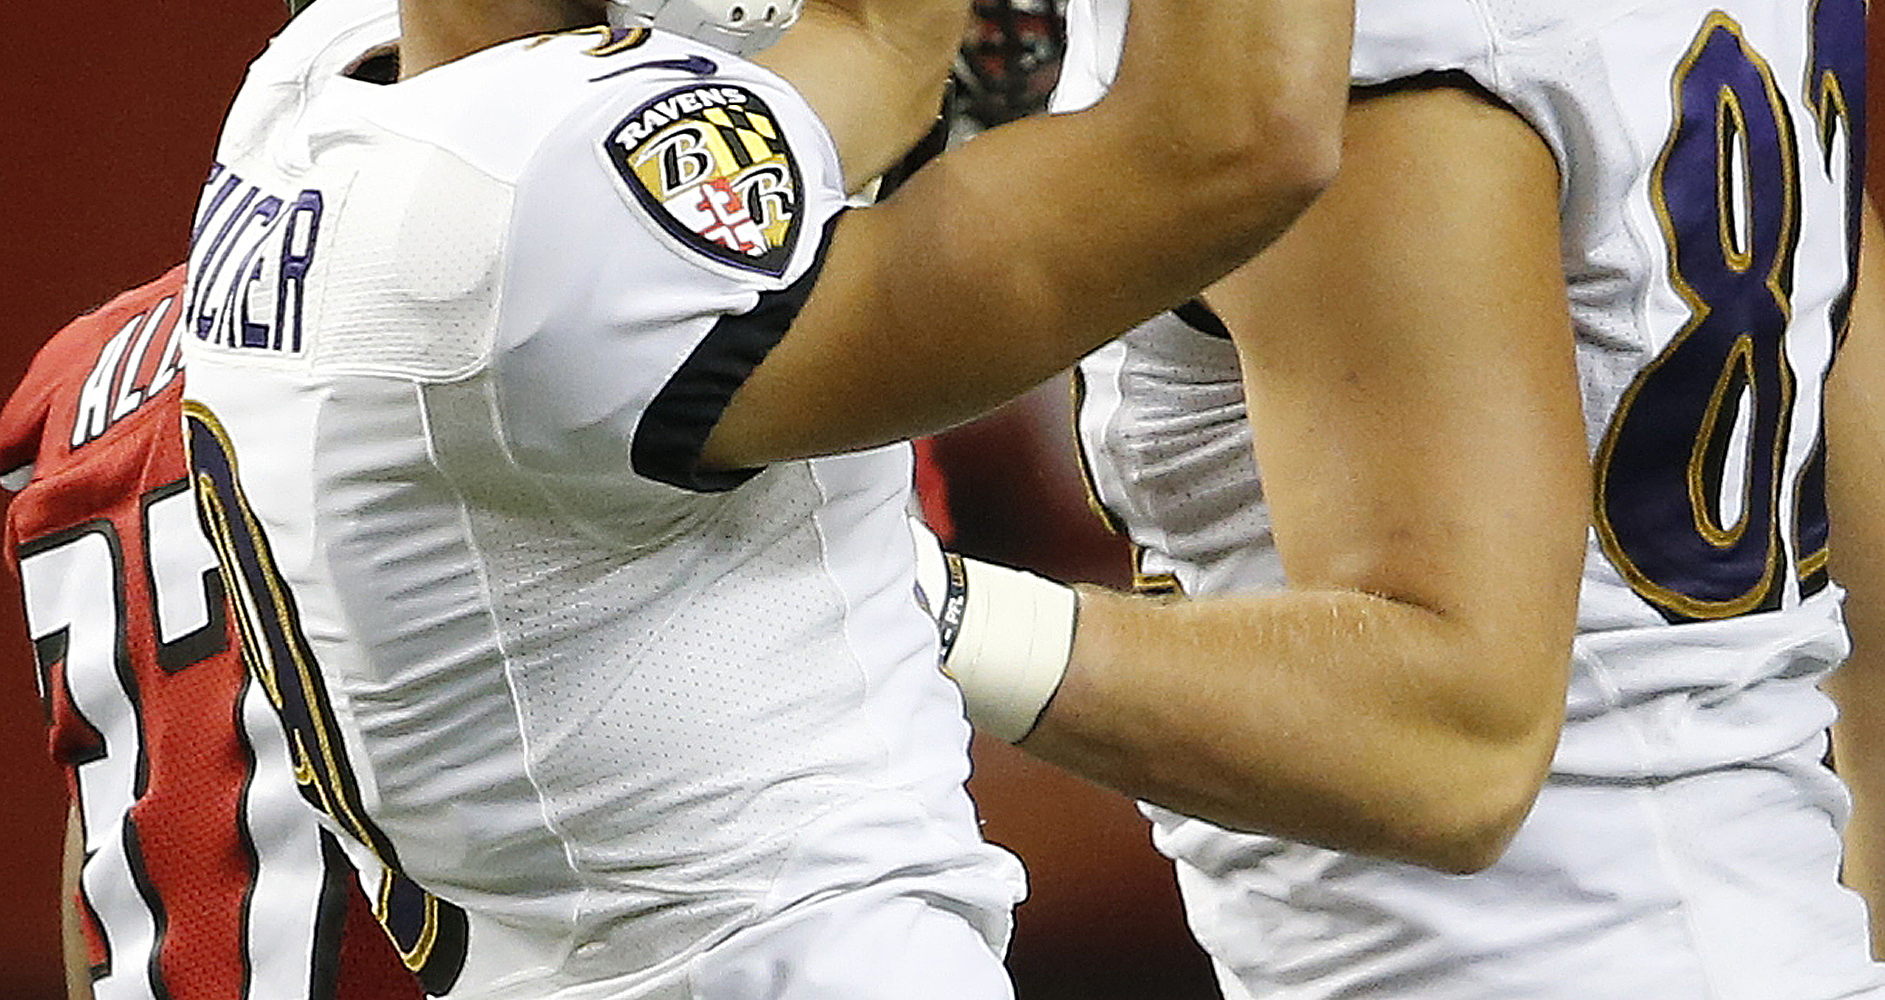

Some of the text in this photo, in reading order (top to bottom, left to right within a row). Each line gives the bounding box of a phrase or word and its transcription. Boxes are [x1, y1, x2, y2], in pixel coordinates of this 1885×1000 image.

[615, 87, 748, 151] RAVENS
[186, 160, 324, 353] UCKER
[70, 293, 187, 452] ALL
